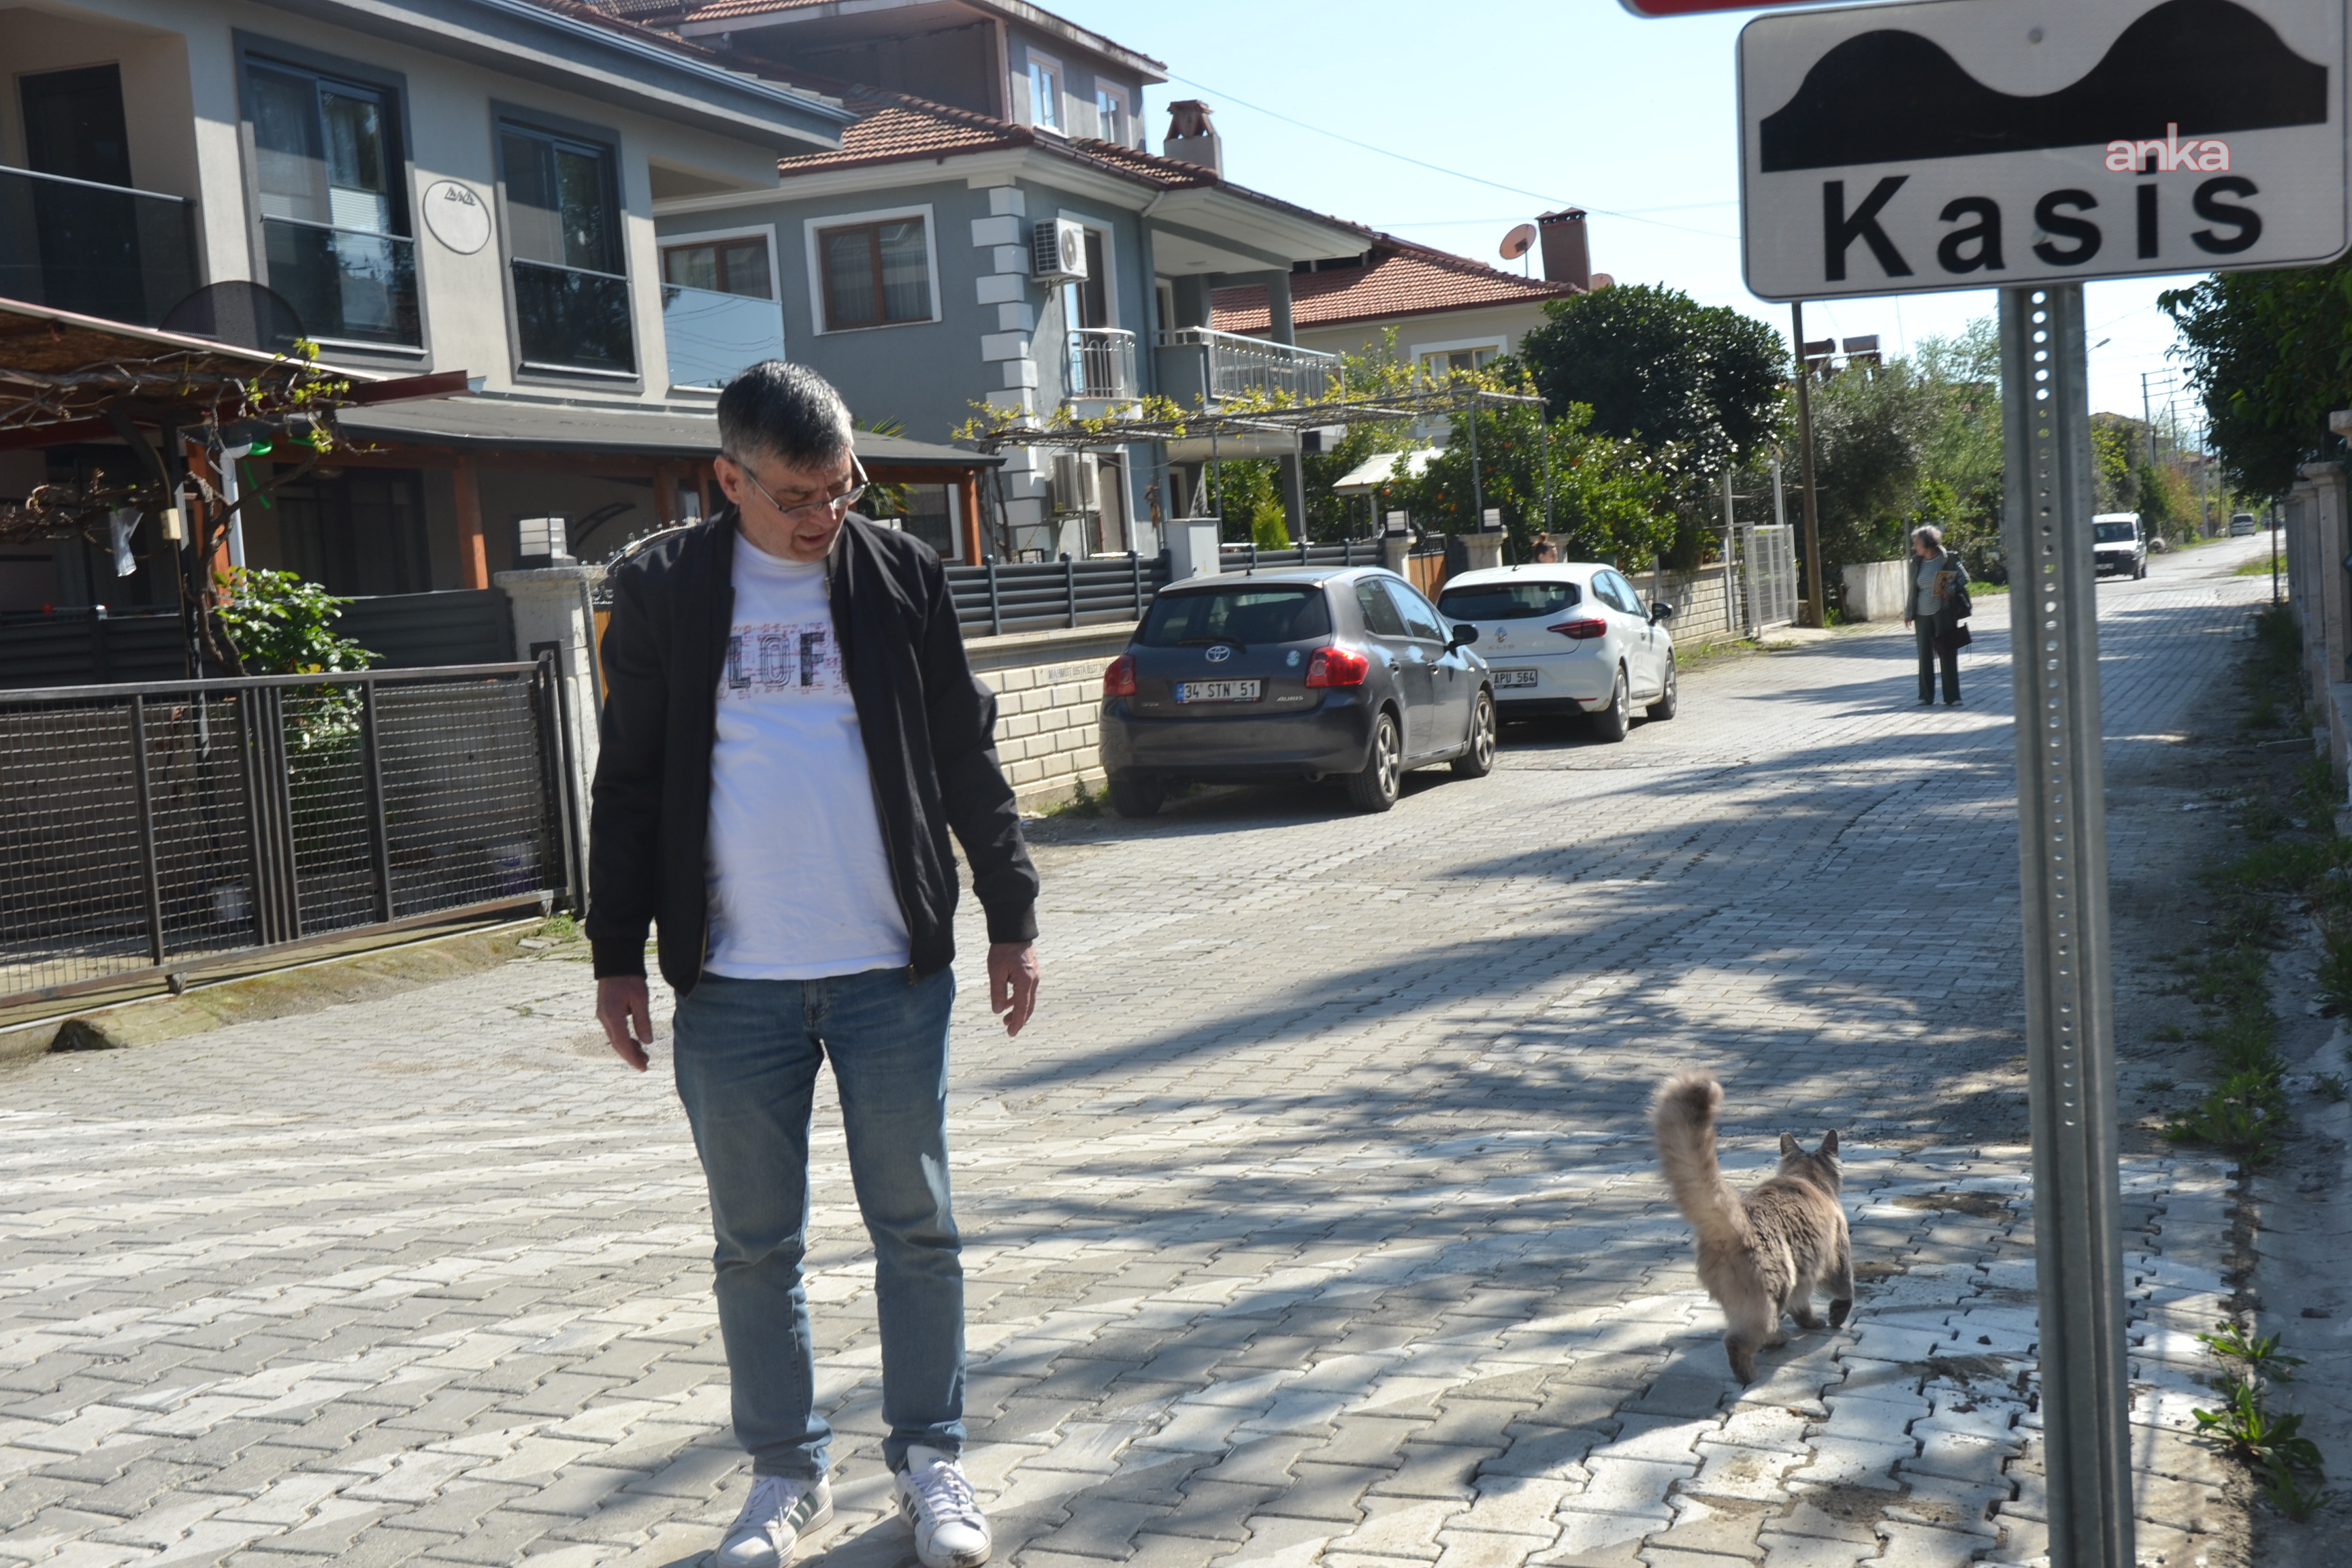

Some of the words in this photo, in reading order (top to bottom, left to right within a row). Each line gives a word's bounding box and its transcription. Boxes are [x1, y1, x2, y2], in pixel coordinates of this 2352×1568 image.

[1823, 155, 2264, 282] Kasis
[728, 630, 849, 689] LOF
[1494, 672, 1512, 684] APU
[1517, 671, 1535, 683] 564
[1185, 684, 1200, 698] 34
[1207, 683, 1230, 698] STN
[1241, 682, 1255, 696] 51
